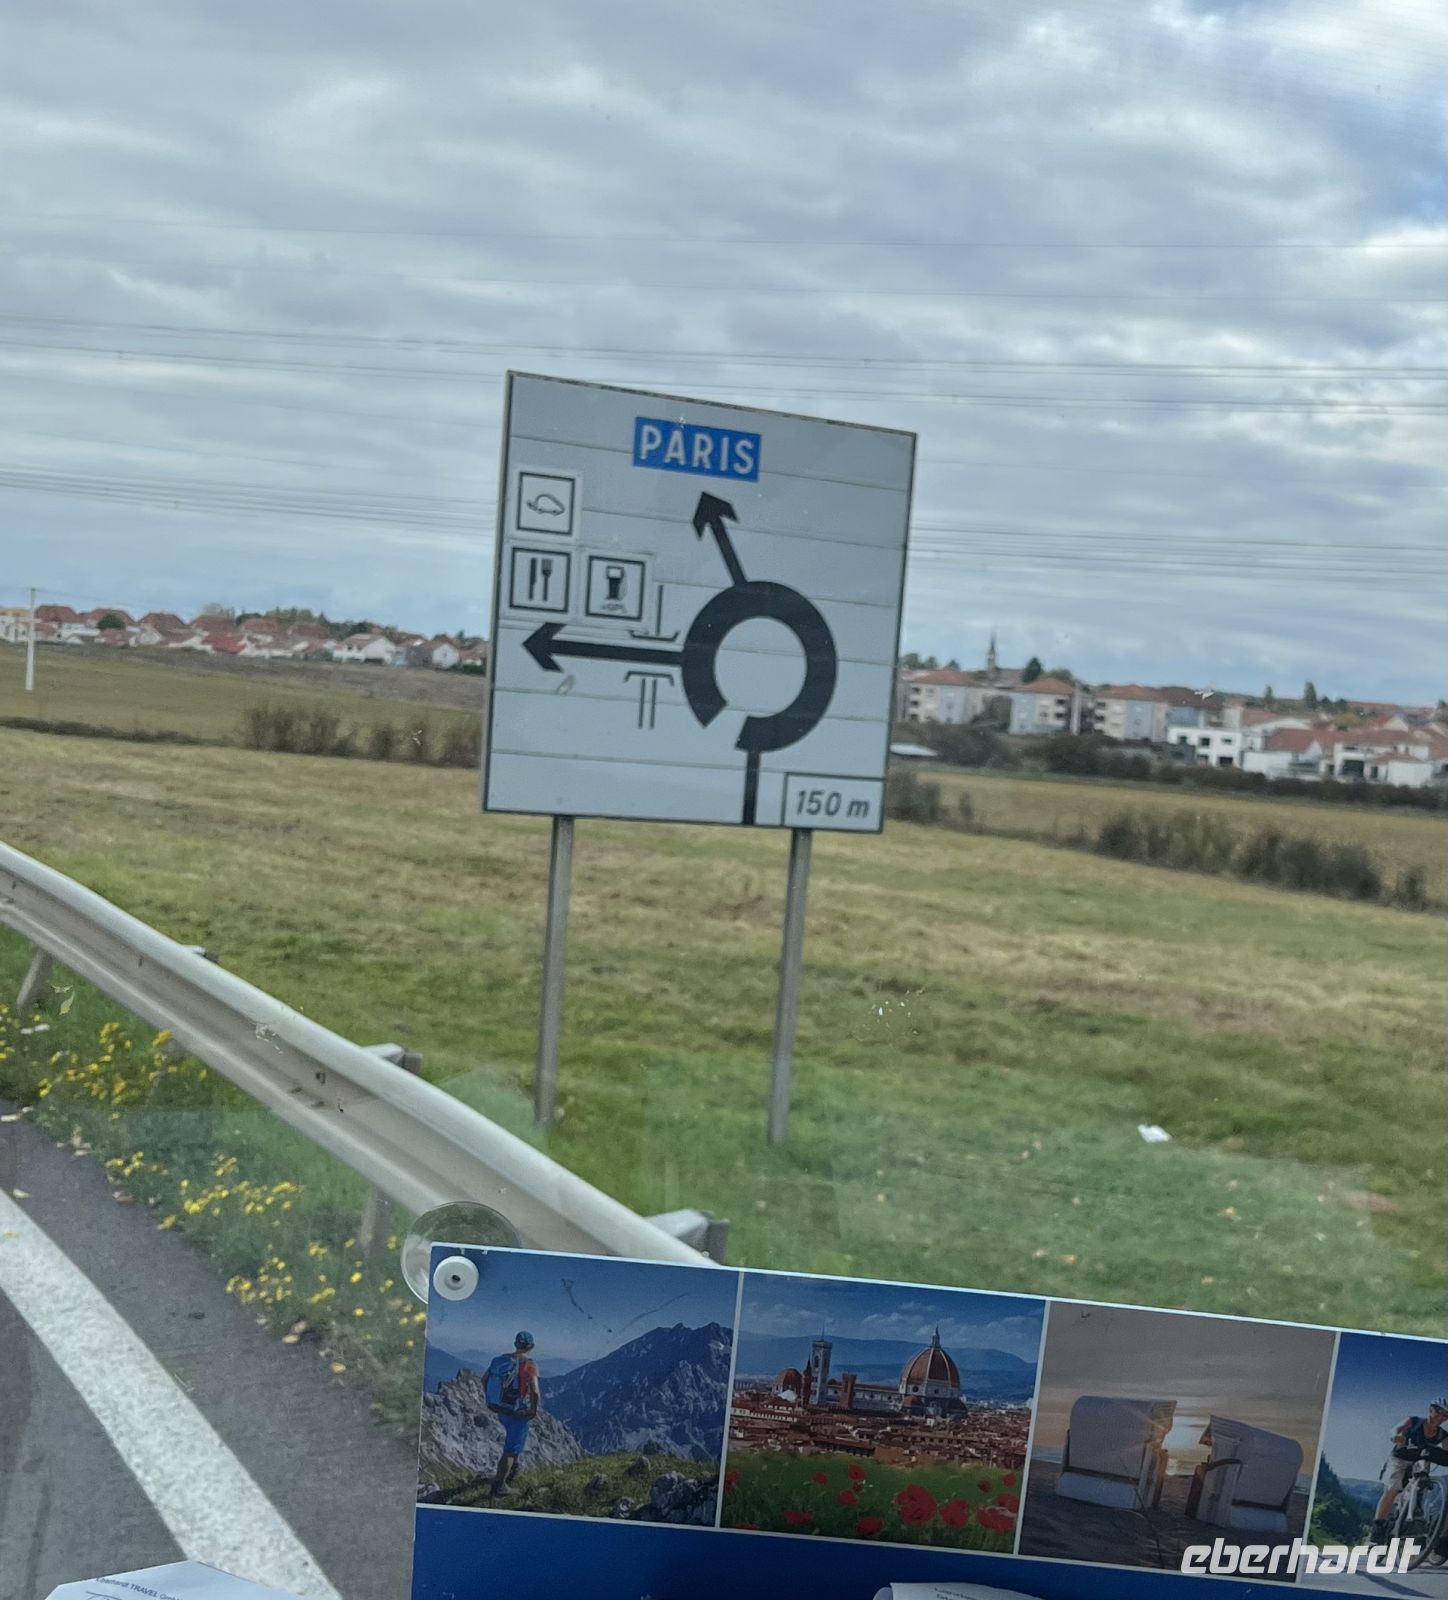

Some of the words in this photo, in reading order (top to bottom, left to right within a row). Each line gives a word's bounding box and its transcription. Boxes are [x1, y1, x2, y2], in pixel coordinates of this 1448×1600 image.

[640, 425, 754, 475] PARIS
[797, 789, 842, 816] 150
[846, 799, 869, 818] m
[130, 1583, 158, 1598] TRAVEL
